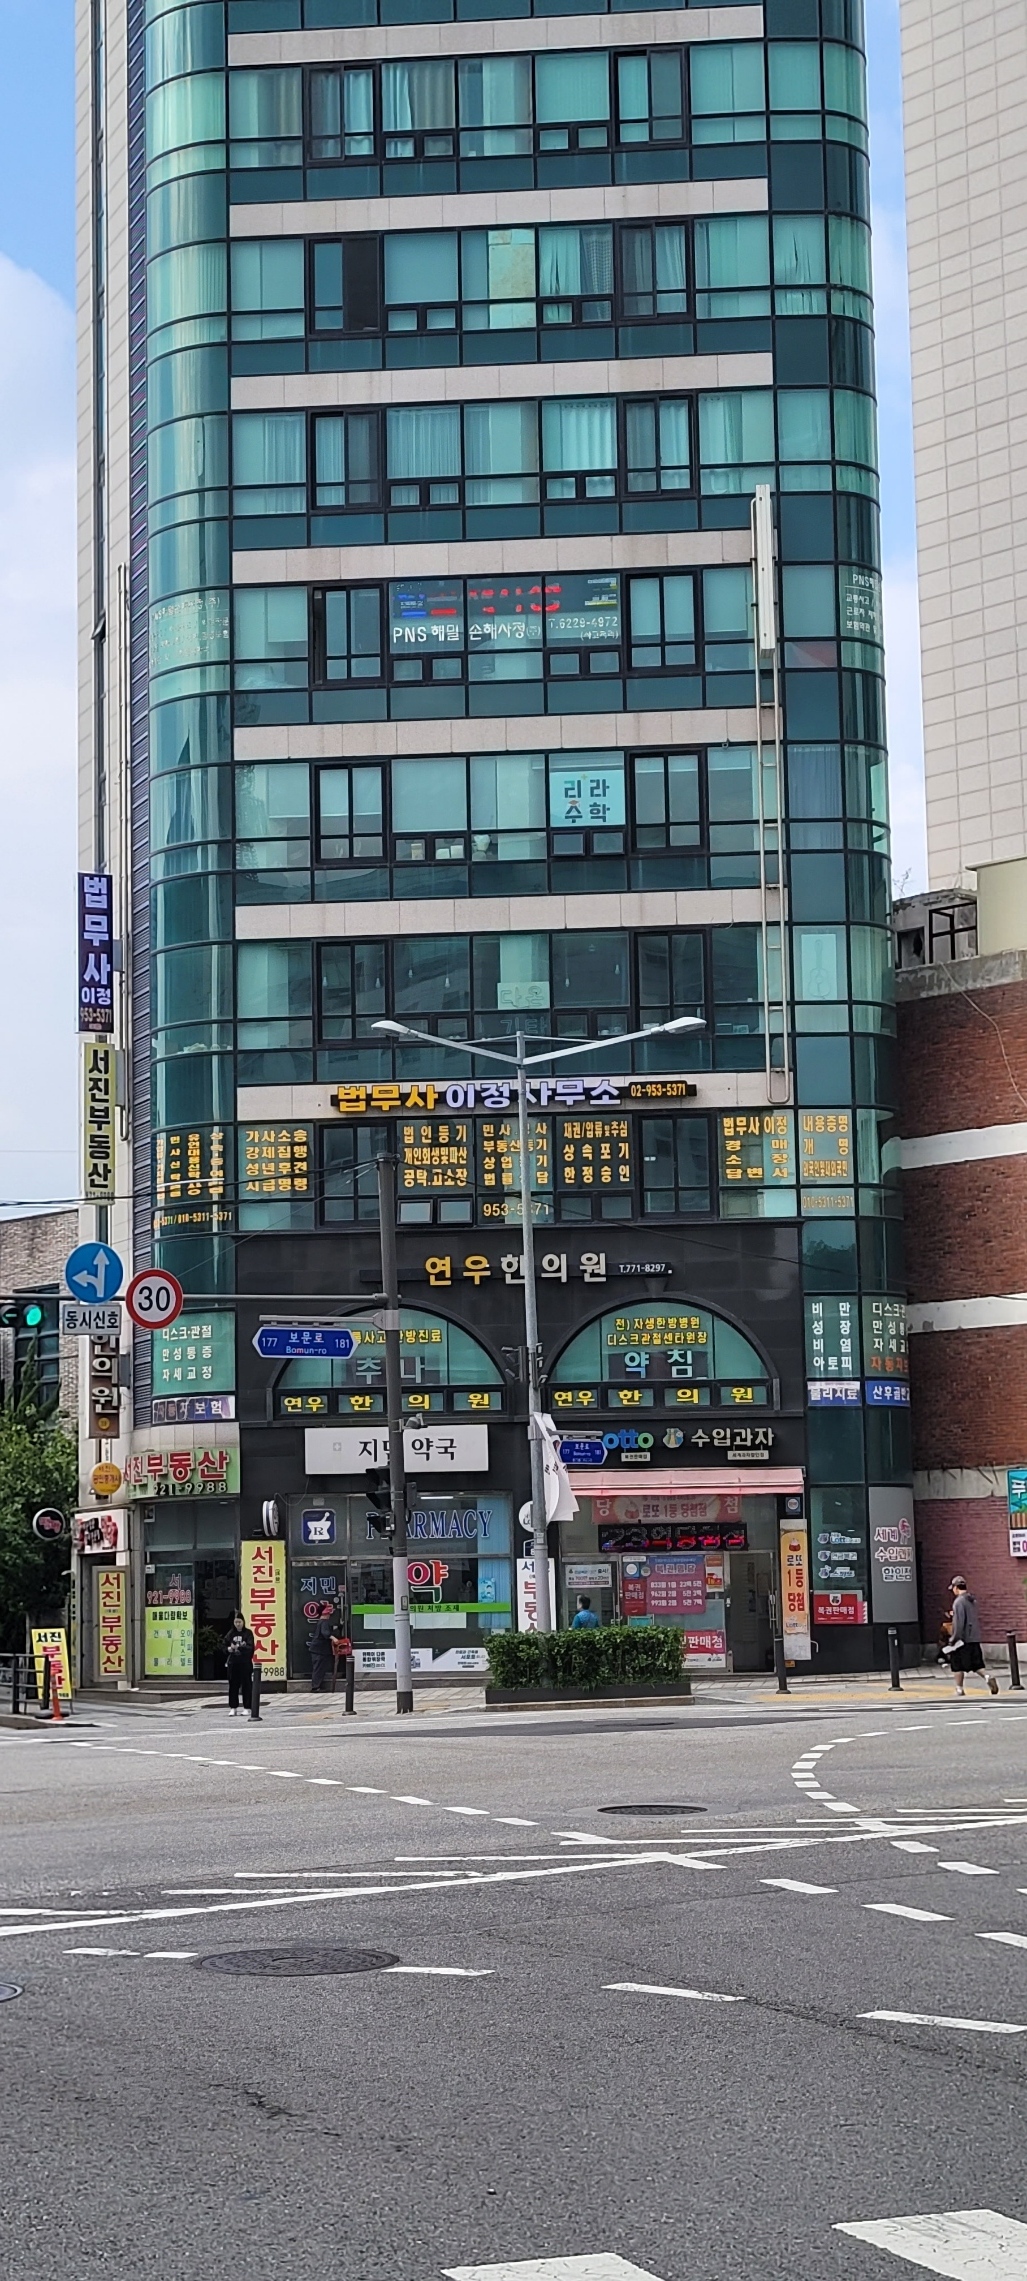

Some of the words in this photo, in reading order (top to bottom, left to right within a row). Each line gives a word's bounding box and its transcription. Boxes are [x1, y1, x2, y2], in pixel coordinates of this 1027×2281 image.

[393, 626, 427, 642] PNS
[430, 624, 459, 641] 해밀
[564, 779, 610, 799] 리라
[564, 801, 611, 824] 수학
[83, 876, 111, 985] 법무사
[81, 986, 111, 1005] 이정
[337, 1084, 439, 1113] 법무사
[445, 1082, 511, 1109] 이정
[518, 1079, 621, 1107] 사무소
[630, 1082, 687, 1098] 02-953-5371
[88, 1048, 112, 1189] 서진부동산
[723, 1116, 760, 1136] 법무사
[763, 1115, 787, 1135] 이정
[803, 1115, 849, 1133] 내용증명
[246, 1129, 308, 1143] 가사소송
[403, 1125, 467, 1144] 법인등기
[246, 1145, 308, 1160] 강제집행
[563, 1142, 629, 1161] 상속포기
[246, 1162, 308, 1176] 성년후견
[483, 1154, 547, 1170] 상업기
[483, 1171, 548, 1187] 법률담
[563, 1164, 630, 1184] 한정승인
[138, 1285, 171, 1312] 30
[812, 1302, 851, 1317] 비만
[65, 1310, 119, 1330] 동시신호
[633, 1316, 700, 1330] 자생한방병원
[811, 1320, 851, 1335] 성장
[261, 1337, 278, 1348] 177
[288, 1331, 325, 1344] 보문로
[334, 1338, 350, 1348] 181
[351, 1329, 442, 1344] 통사고방진료
[607, 1331, 708, 1346] 디스크관절센타원장
[812, 1338, 852, 1353] 비염
[162, 1345, 213, 1362] 만성통증
[285, 1345, 327, 1355] Bomun-ro
[624, 1349, 692, 1379] 약침
[813, 1356, 852, 1371] 아토피
[162, 1365, 213, 1382] 자세교정
[690, 1427, 775, 1447] 수입과자
[123, 1449, 229, 1483] 서진부동산
[1011, 1479, 1027, 1499] 푸
[787, 1554, 803, 1567] 로또
[300, 1576, 337, 1597] 지민
[787, 1568, 804, 1588] 1등
[250, 1545, 279, 1664] 서진부동산
[787, 1592, 805, 1613] 당첨
[36, 1632, 62, 1643] 서진
[260, 1667, 285, 1678] -9988
